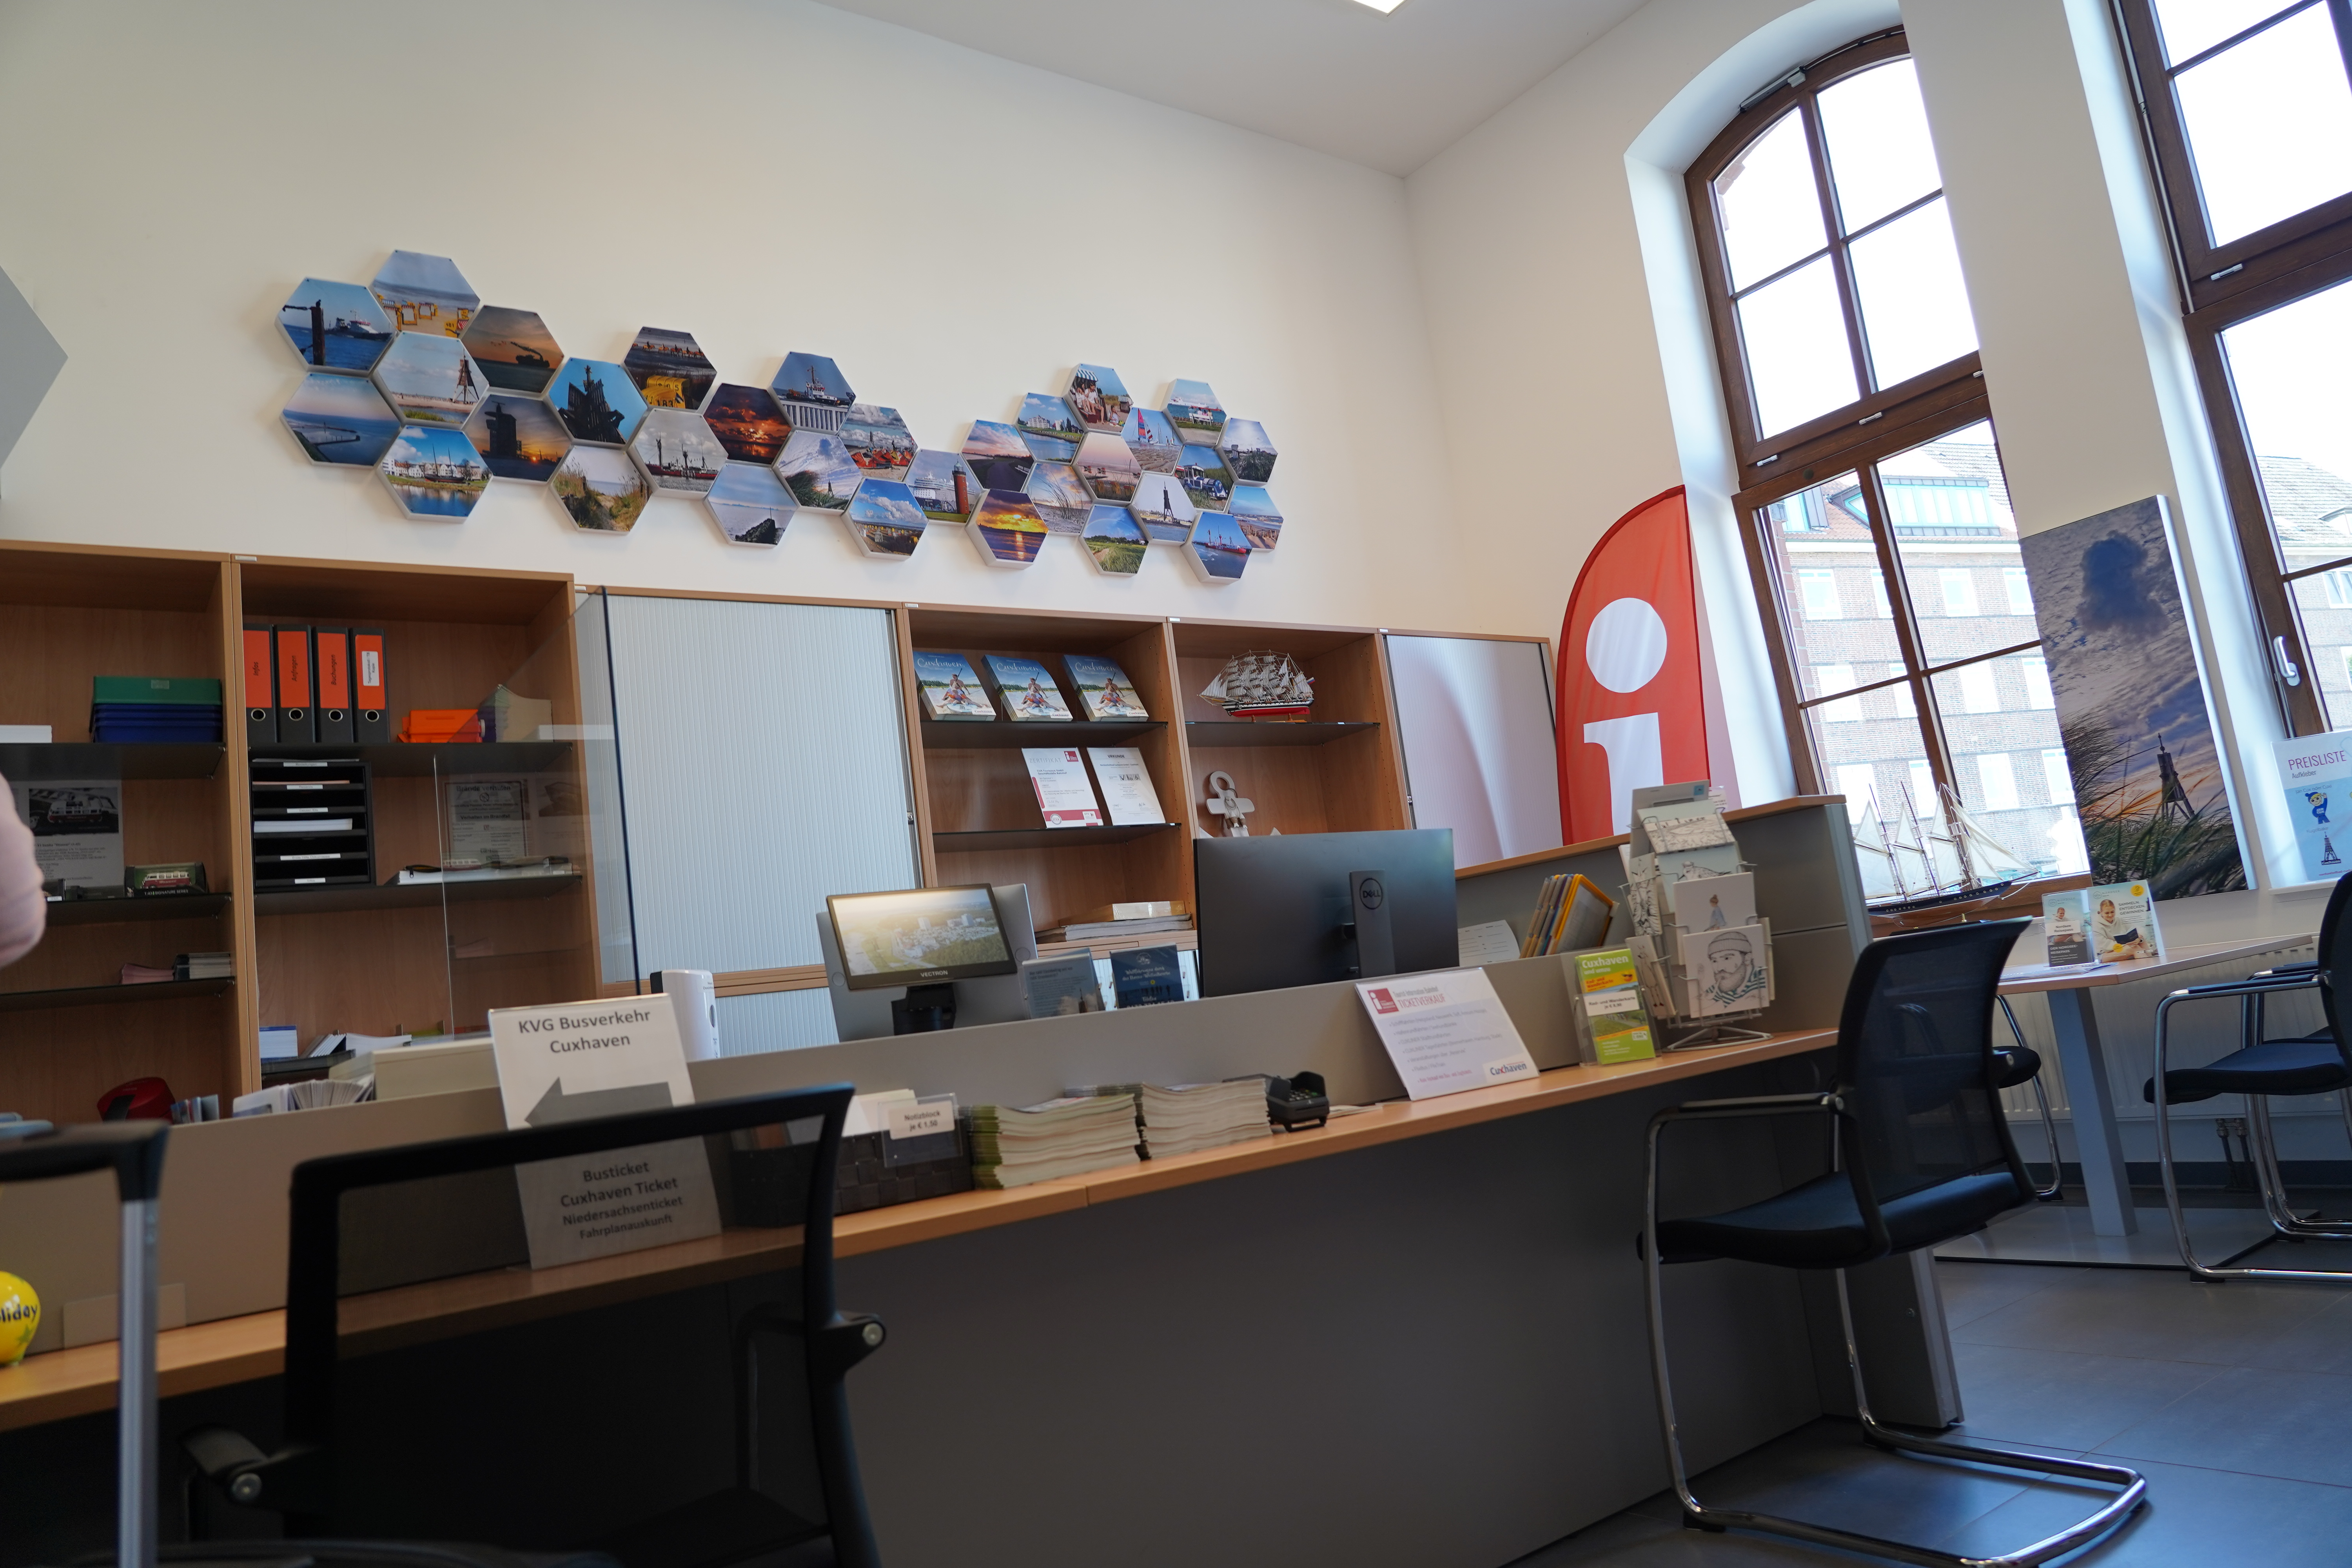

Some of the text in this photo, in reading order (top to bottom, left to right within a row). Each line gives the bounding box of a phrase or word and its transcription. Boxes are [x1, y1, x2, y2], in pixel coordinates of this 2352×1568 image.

[2288, 750, 2347, 770] PREISLISTE
[2292, 770, 2316, 779] Aufkleber
[1363, 890, 1381, 898] DELL
[1581, 956, 1629, 968] Cuxhaven
[1397, 993, 1446, 1009] TICKETVERKAUF
[519, 1009, 650, 1033] KVG Busverkehr
[550, 1036, 631, 1053] Cuxhaven
[1490, 1062, 1527, 1075] Cuxhaven
[904, 1110, 940, 1121] Notizblock
[583, 1161, 650, 1182] Busticket
[561, 1178, 679, 1207] Cuxhaven Ticket
[563, 1196, 683, 1225] Niedersachsenticket
[580, 1214, 673, 1239] Fahrplanauskunft
